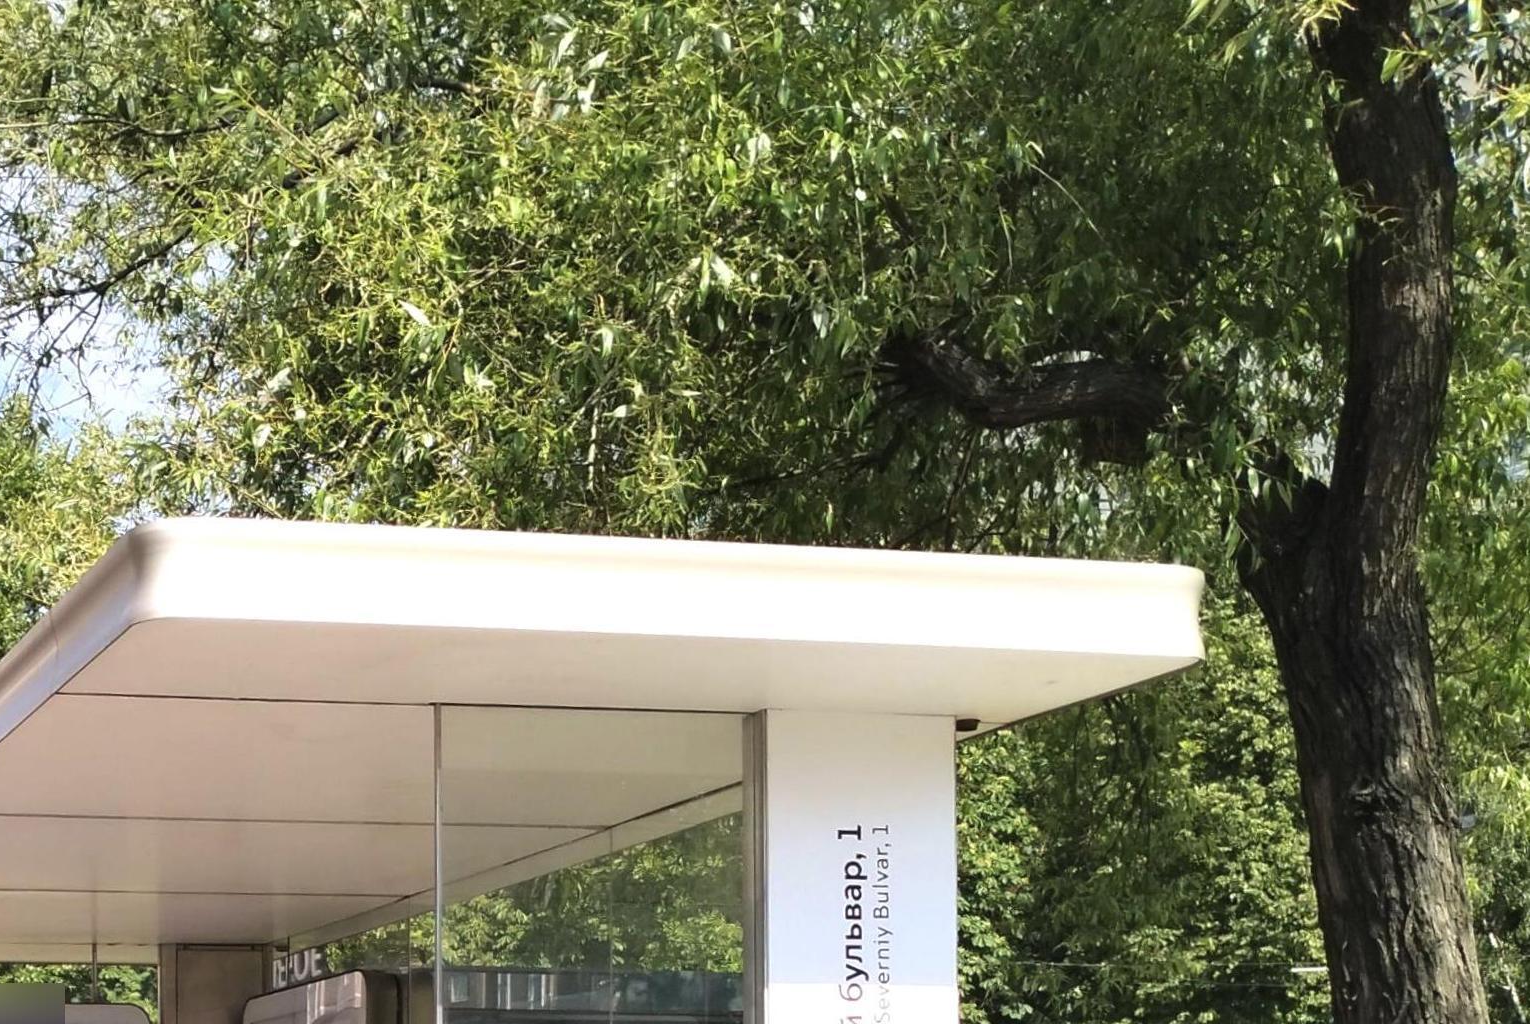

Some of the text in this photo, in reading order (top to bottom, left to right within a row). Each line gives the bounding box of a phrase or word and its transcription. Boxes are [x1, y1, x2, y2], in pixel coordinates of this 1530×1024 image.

[837, 823, 863, 841] 1
[839, 852, 869, 1002] бульвар,
[872, 823, 893, 1024] Severniy Bulvar, 1
